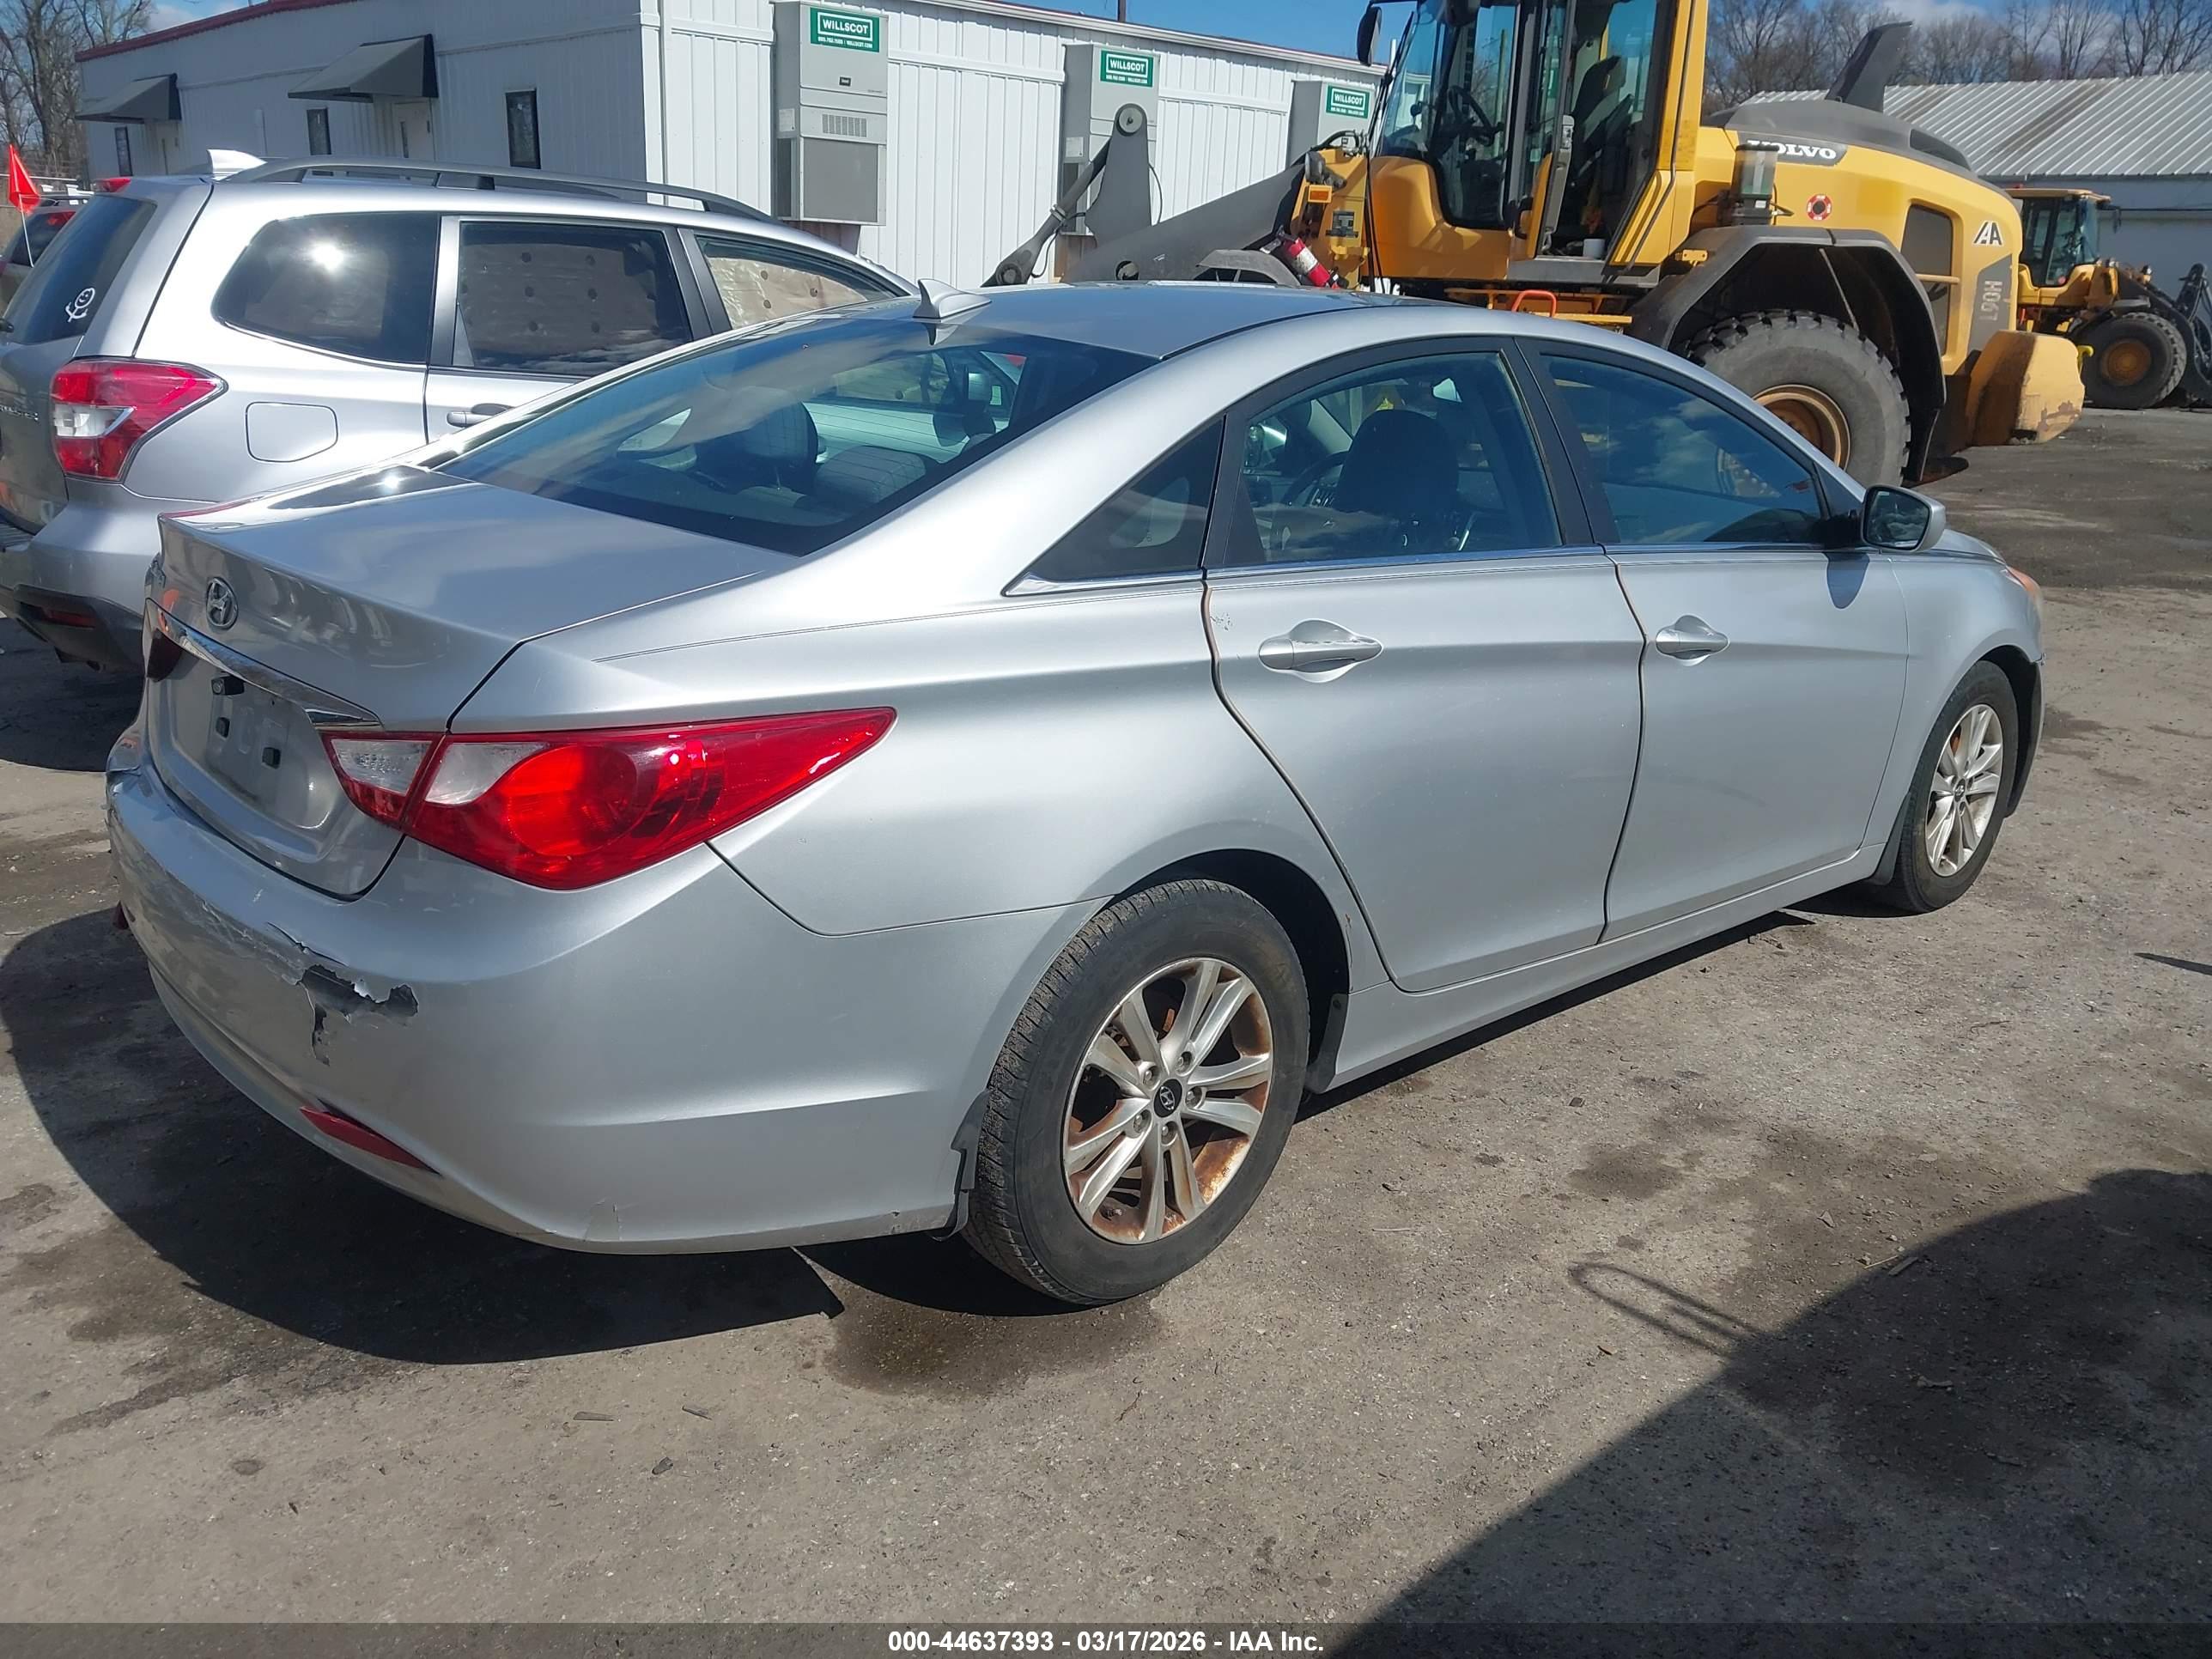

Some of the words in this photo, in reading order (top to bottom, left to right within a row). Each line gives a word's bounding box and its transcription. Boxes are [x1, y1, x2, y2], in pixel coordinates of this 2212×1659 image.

[823, 19, 869, 34] WILLSCOT
[1109, 58, 1145, 73] WILLSCOT
[1334, 93, 1363, 106] WILLSCOT
[1747, 140, 1837, 159] OLVO
